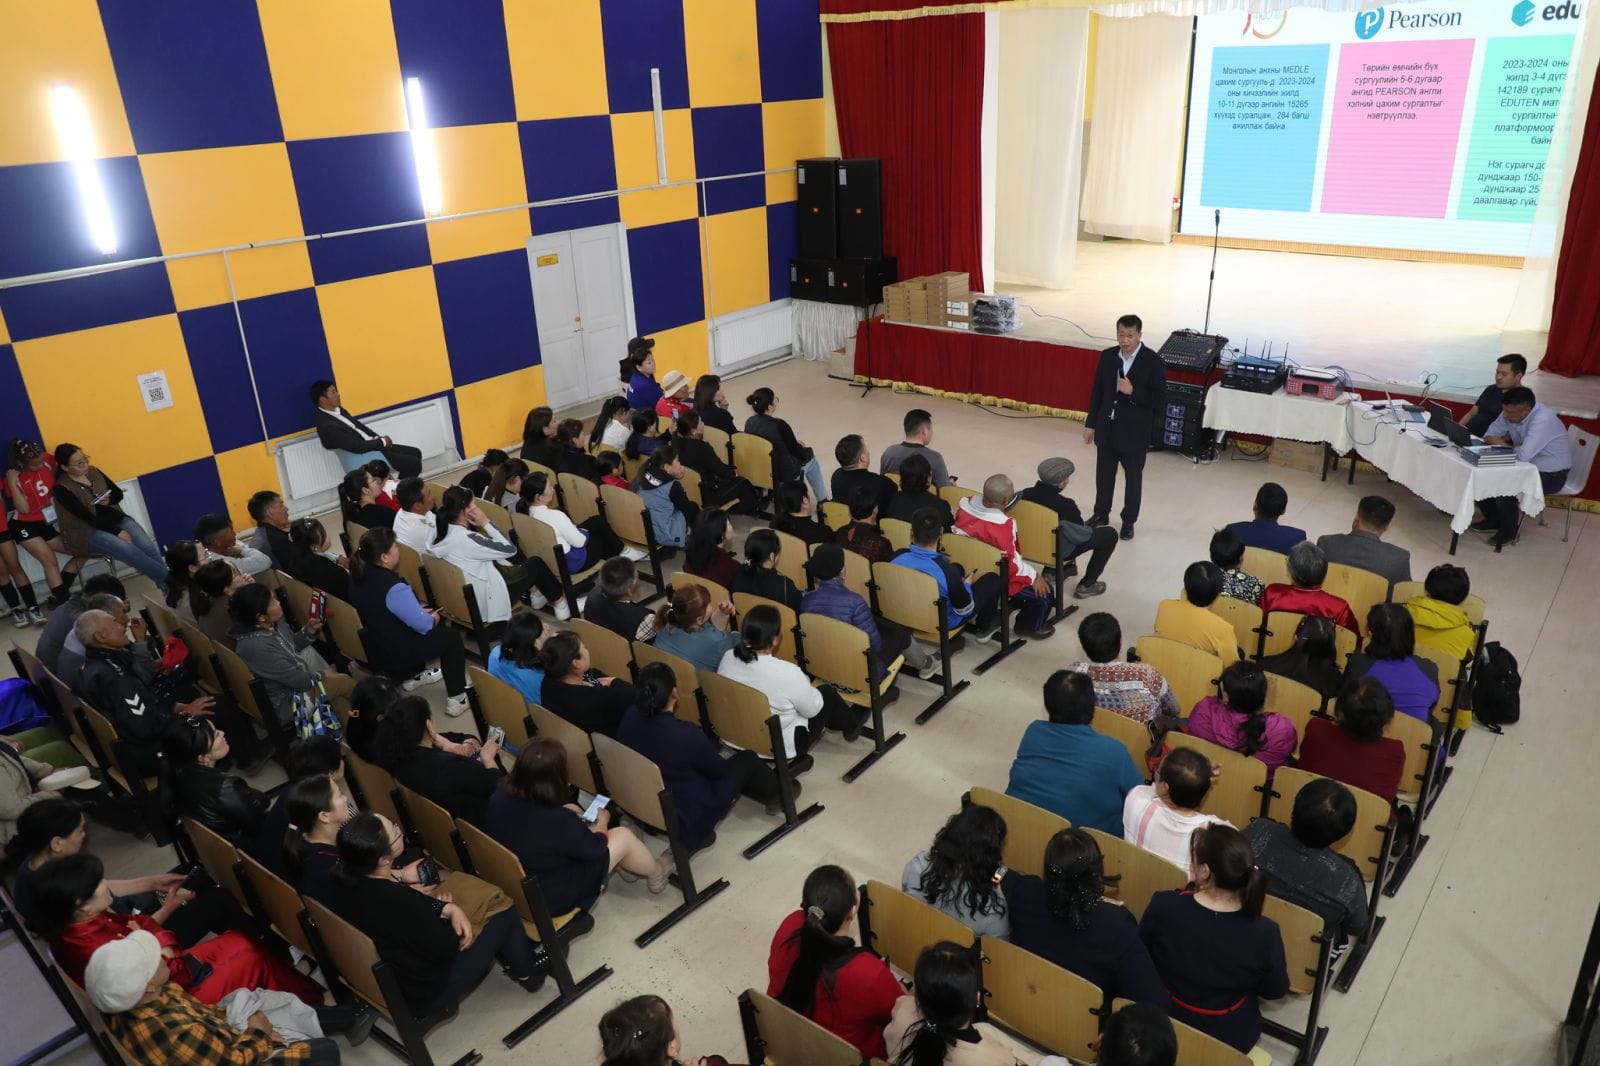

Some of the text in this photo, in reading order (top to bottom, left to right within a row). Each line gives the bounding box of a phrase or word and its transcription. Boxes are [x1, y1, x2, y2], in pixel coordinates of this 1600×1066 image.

[1389, 10, 1462, 29] Pearson
[1503, 59, 1548, 69] 2023-2024
[1279, 77, 1315, 85] 2023-2024
[1400, 75, 1413, 83] 5-6
[1414, 76, 1442, 85] дугаар
[1505, 74, 1529, 82] жилд
[1532, 72, 1545, 81] 3-4
[1351, 88, 1373, 96] ангид
[1375, 87, 1416, 95] PEARSON
[1498, 86, 1528, 94] 142189
[1218, 100, 1235, 108] 10-11
[1288, 100, 1308, 108] 15265
[1402, 101, 1442, 109] сургалтыг
[1500, 99, 1540, 107] EDUTEN
[1488, 160, 1503, 169] Нэг
[1505, 161, 1534, 170] сурагч
[1477, 174, 1520, 182] дунджаар
[1483, 185, 1526, 194] дунджаар
[1473, 197, 1517, 206] даалгавар
[36, 480, 49, 496] 5
[20, 529, 29, 538] 5
